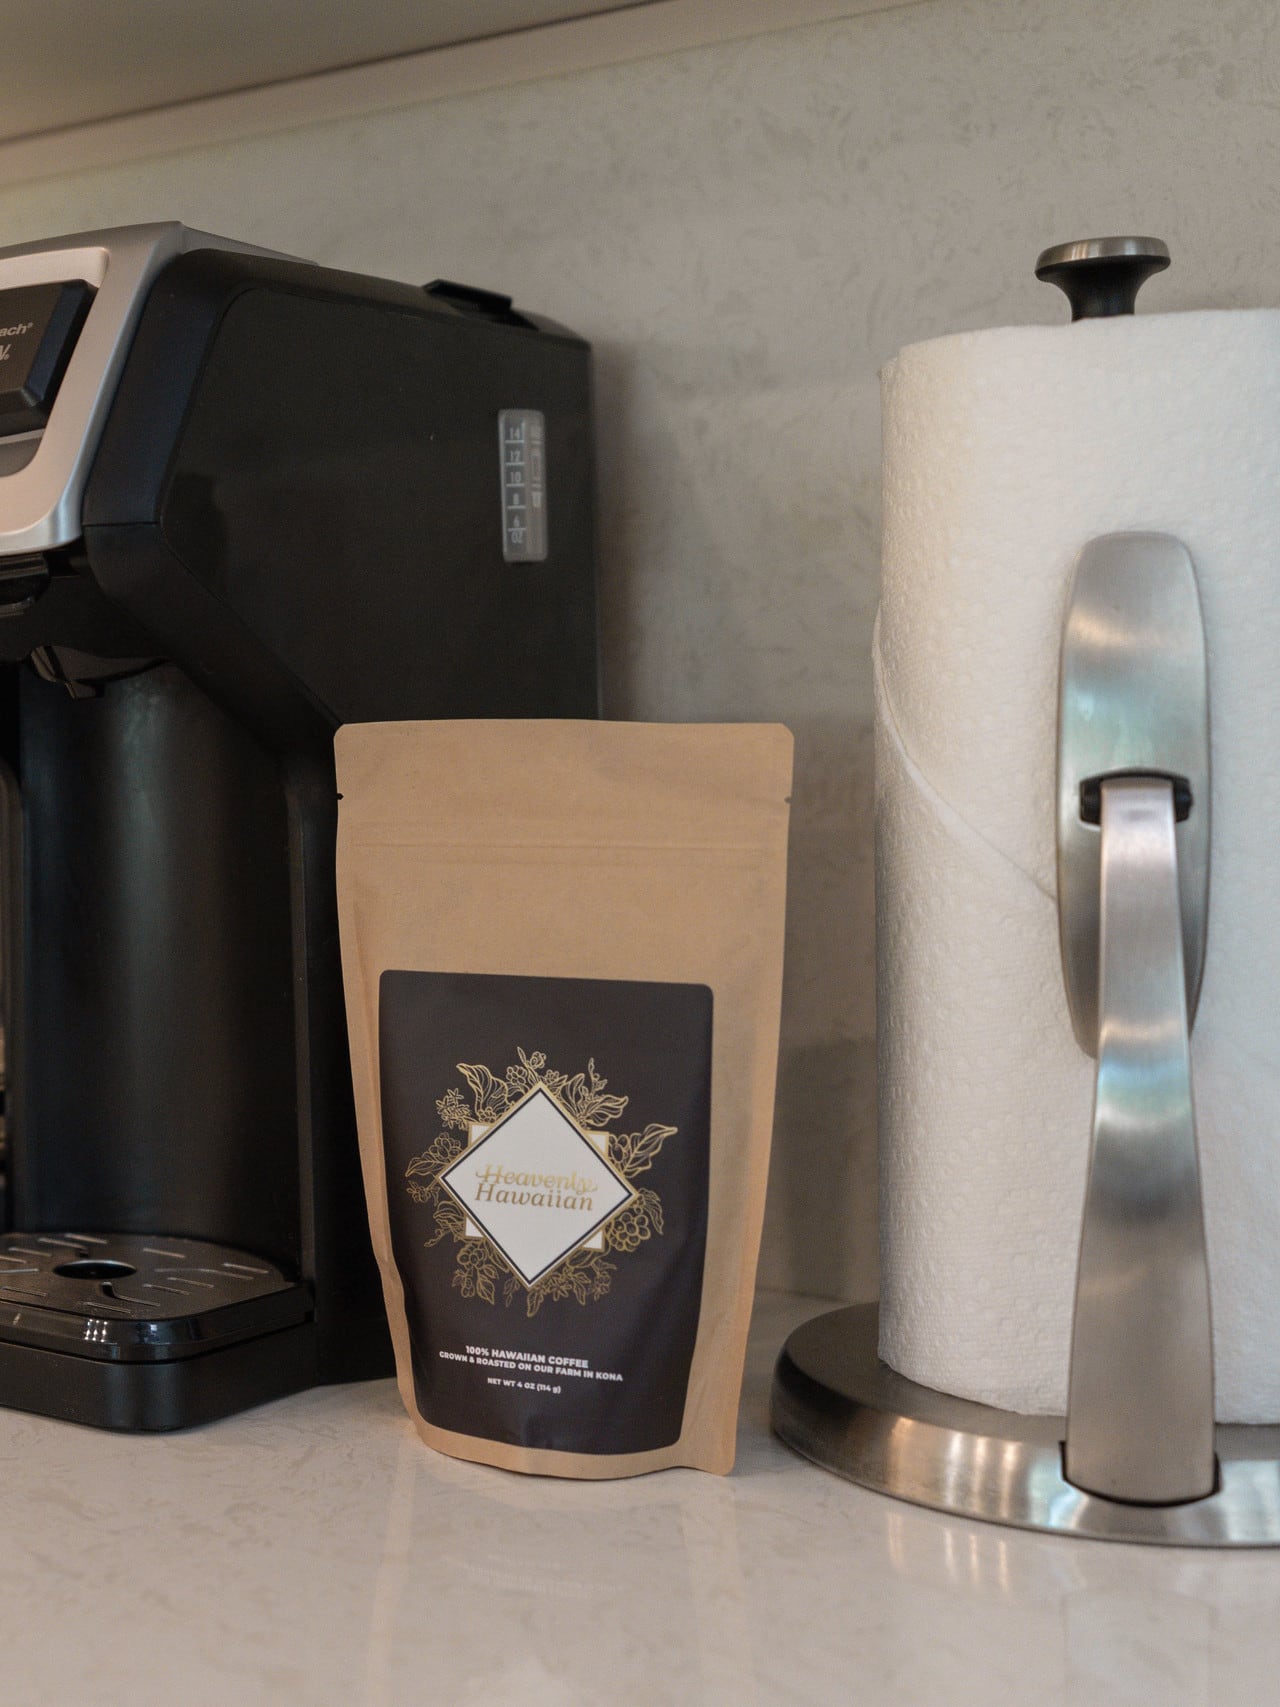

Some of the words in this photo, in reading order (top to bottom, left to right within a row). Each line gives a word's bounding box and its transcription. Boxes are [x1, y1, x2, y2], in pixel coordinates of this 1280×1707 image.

[509, 427, 520, 438] 14
[510, 451, 521, 462] 12
[510, 472, 522, 483] 10
[475, 1164, 598, 1195] Heavenly
[475, 1182, 593, 1211] Hawaiian
[439, 1351, 468, 1363] GROWN
[469, 1356, 475, 1364] &
[476, 1357, 516, 1369] ROASTED
[518, 1362, 532, 1371] ON
[533, 1364, 554, 1374] OUR
[555, 1367, 582, 1377] FARM
[583, 1370, 594, 1379] IN
[595, 1371, 624, 1382] KONA
[465, 1345, 489, 1357] 100%
[491, 1349, 546, 1364] HAWAIIAN
[548, 1356, 589, 1369] COFFEE
[487, 1377, 501, 1385] NET
[503, 1379, 516, 1388] WT
[524, 1382, 536, 1390] OZ
[536, 1383, 552, 1392] (114
[552, 1385, 561, 1394] g)
